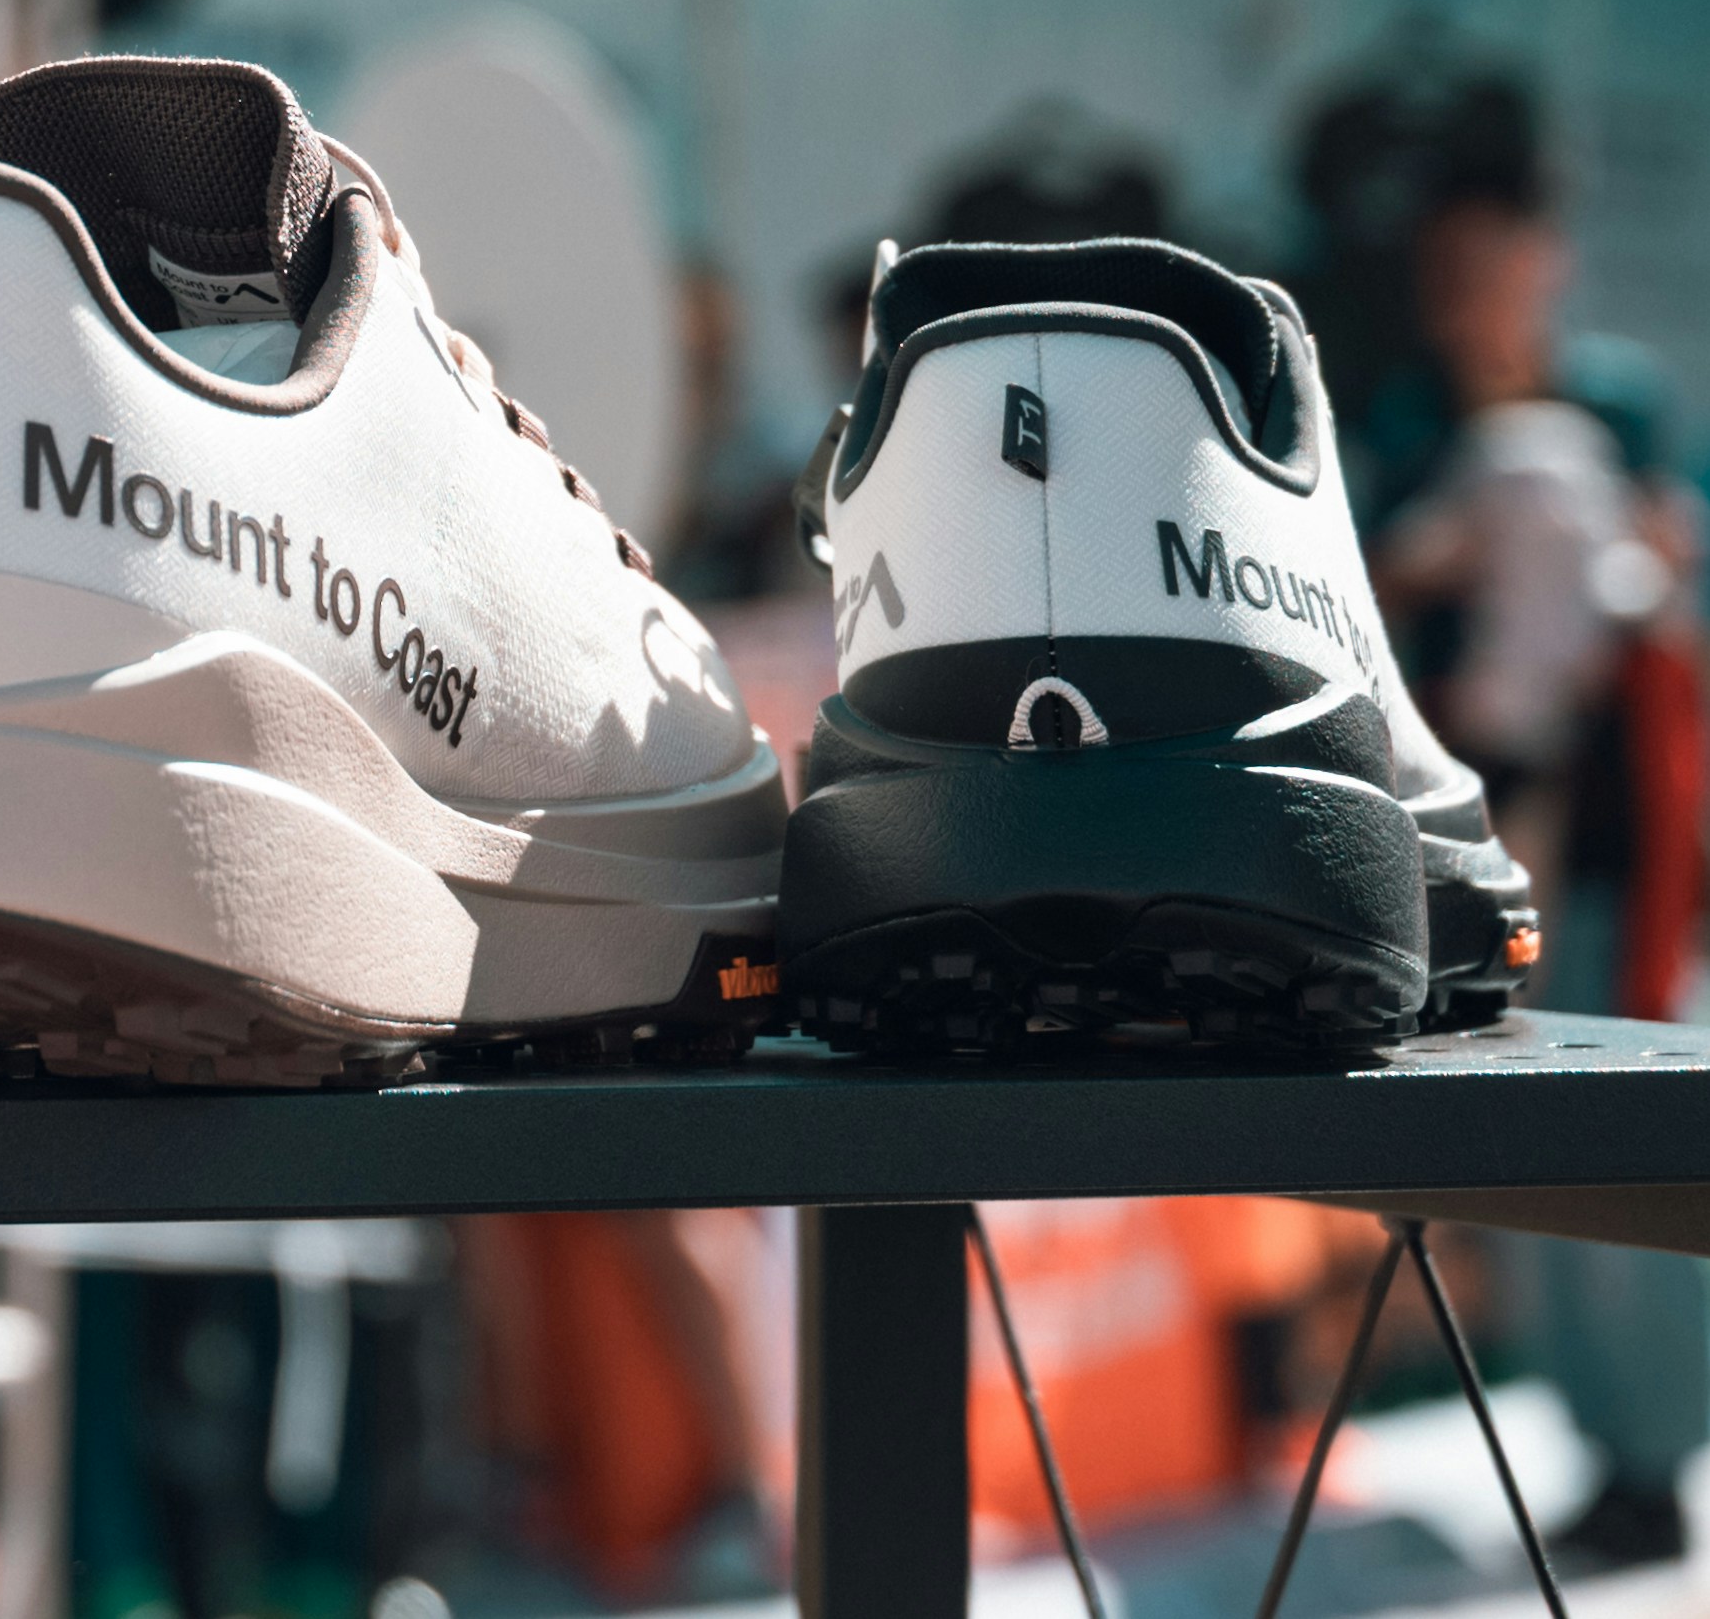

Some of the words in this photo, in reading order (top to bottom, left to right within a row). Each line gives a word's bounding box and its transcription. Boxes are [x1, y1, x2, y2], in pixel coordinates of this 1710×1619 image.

[1018, 399, 1041, 446] T1
[23, 421, 292, 598] Mount
[310, 536, 361, 636] to
[372, 578, 477, 748] Coast
[1156, 520, 1345, 647] Mount
